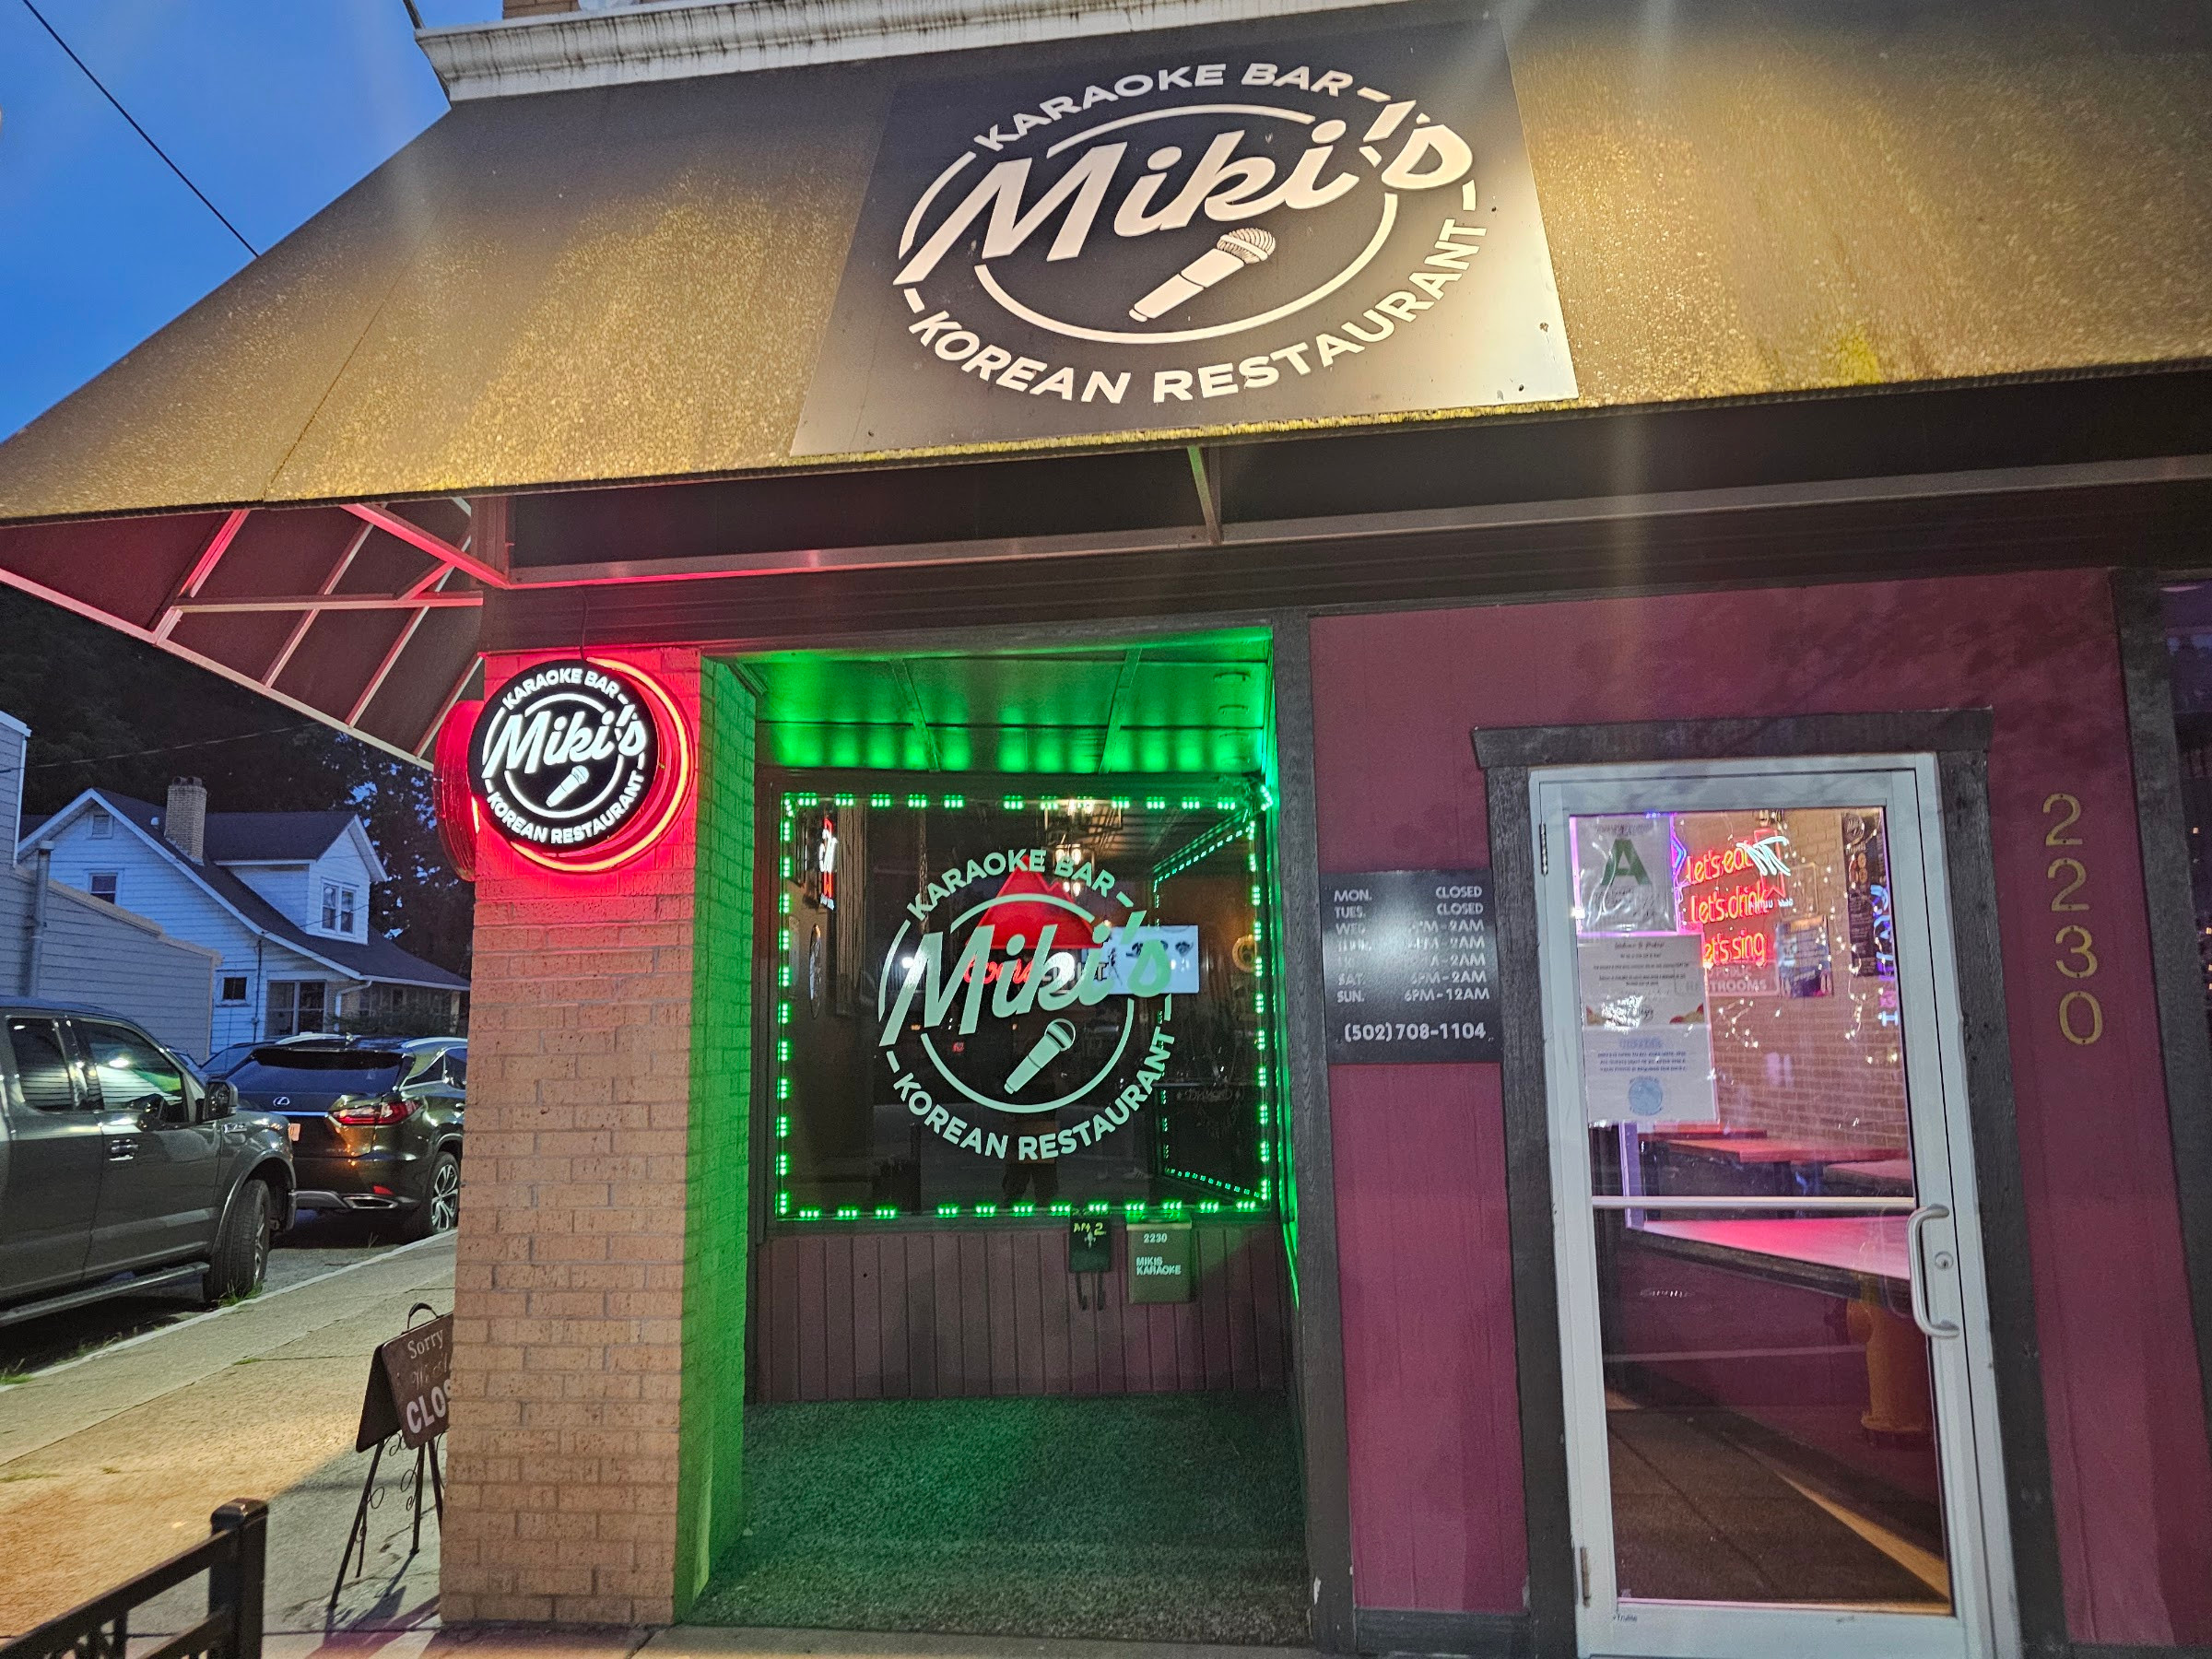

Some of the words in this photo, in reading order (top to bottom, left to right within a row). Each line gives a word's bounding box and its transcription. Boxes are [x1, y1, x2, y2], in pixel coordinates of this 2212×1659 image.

[974, 63, 1226, 152] KARAOKE
[1241, 63, 1354, 98] BAR
[893, 100, 1474, 286] Miki's
[909, 311, 1132, 404] KOREAN
[1153, 218, 1488, 404] RESTAURANT
[502, 667, 582, 710] KARAOKE
[584, 670, 620, 699] BAR
[481, 704, 647, 779] Miki's
[487, 793, 548, 843] KOREAN
[551, 771, 644, 844] RESTAURANT
[907, 849, 1047, 920] KARAOKE
[1055, 856, 1116, 898] BAR
[1600, 839, 1653, 886] A
[1334, 888, 1372, 902] MON.
[1435, 886, 1483, 899] CLOSED
[1436, 902, 1484, 916] CLOSED
[1727, 880, 1769, 917] drink
[2042, 793, 2103, 1045] 2230
[1704, 933, 1731, 965] et's
[1732, 929, 1767, 967] sing
[878, 910, 1171, 1046] Miki's
[1336, 990, 1364, 1003] SUN.
[894, 1073, 1007, 1160] KOREAN
[1018, 1027, 1175, 1161] RESTAURANT
[1094, 1221, 1107, 1236] 2
[1143, 1232, 1168, 1243] 2230
[1135, 1256, 1163, 1266] MIKIS
[406, 1329, 444, 1359] Sorry
